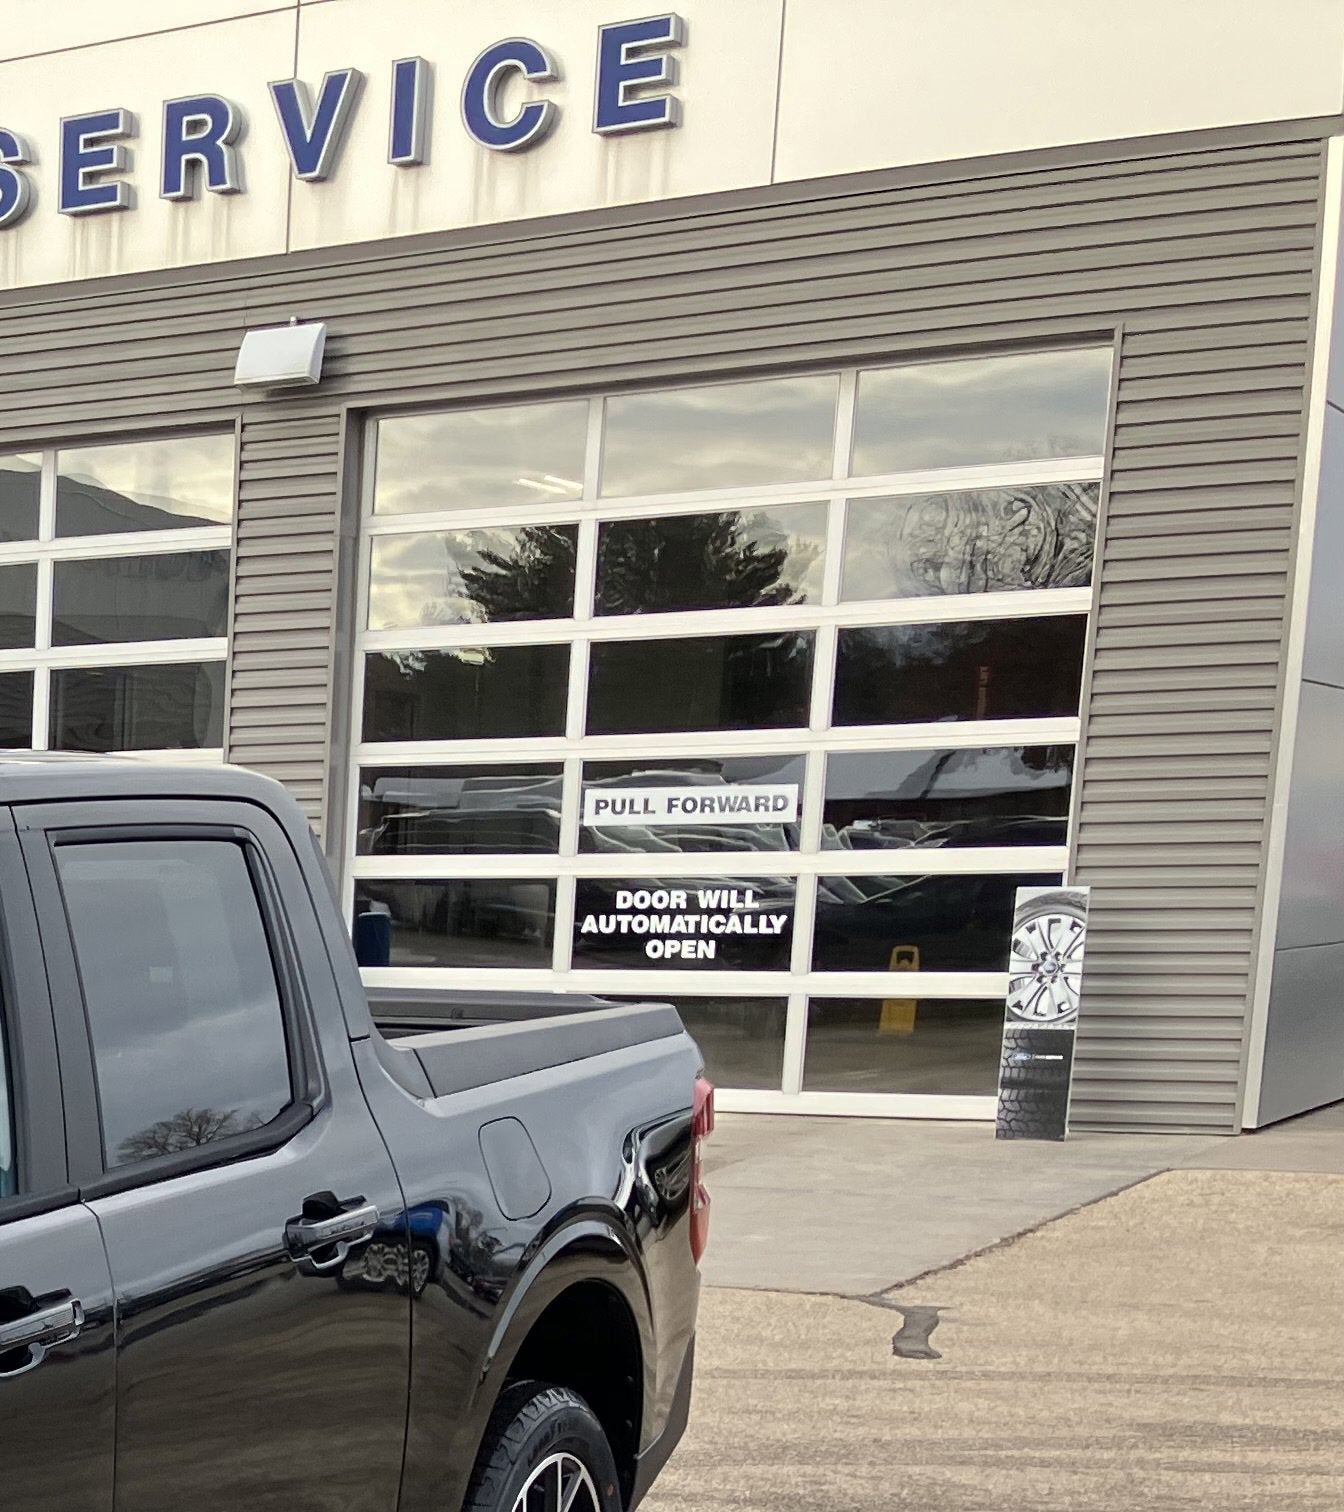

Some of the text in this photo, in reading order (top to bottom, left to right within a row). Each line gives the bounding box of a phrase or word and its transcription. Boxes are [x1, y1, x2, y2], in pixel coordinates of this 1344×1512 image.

[594, 794, 789, 816] PULL FORWARD
[615, 889, 760, 910] DOOR WILL
[580, 914, 788, 934] AUTOMATICALLY
[645, 939, 716, 959] OPEN
